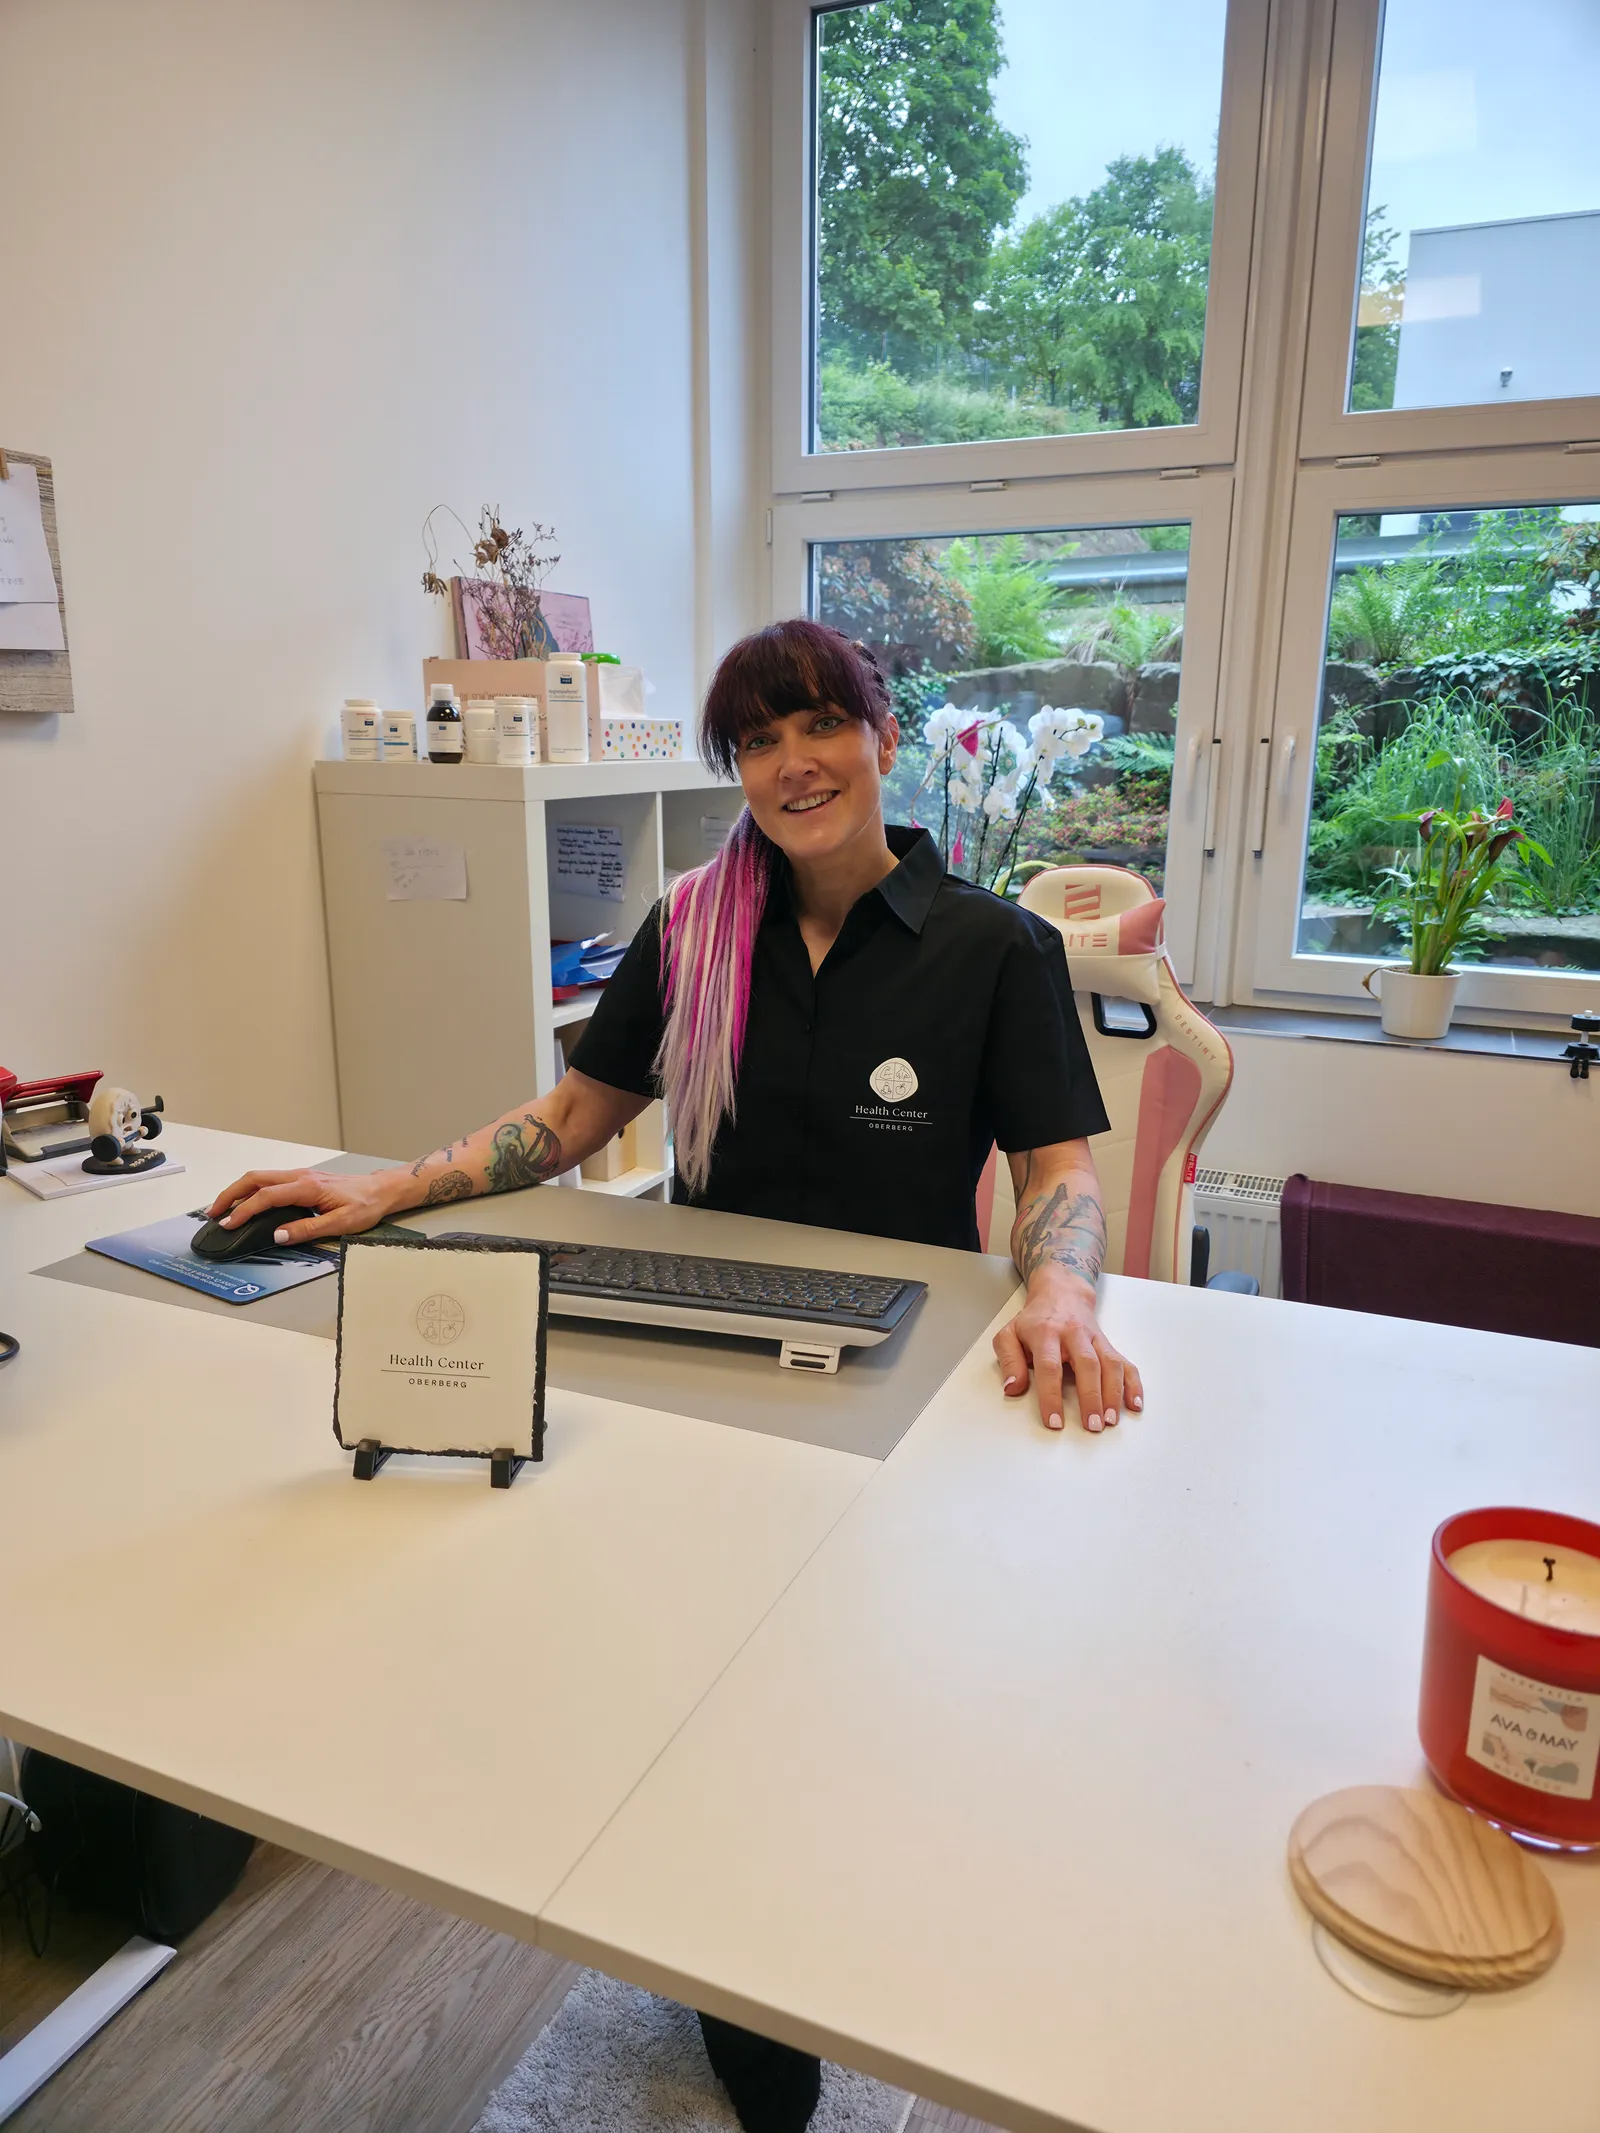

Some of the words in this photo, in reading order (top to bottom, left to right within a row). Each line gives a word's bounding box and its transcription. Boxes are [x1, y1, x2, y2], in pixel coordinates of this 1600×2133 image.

[1063, 933, 1107, 948] ITE
[1174, 1014, 1217, 1061] DESTINY
[855, 1105, 889, 1116] Health
[892, 1108, 928, 1119] Center
[868, 1122, 913, 1132] OBERBERG
[389, 1354, 433, 1367] Health
[437, 1357, 485, 1370] Center
[408, 1378, 467, 1388] OBERBERG
